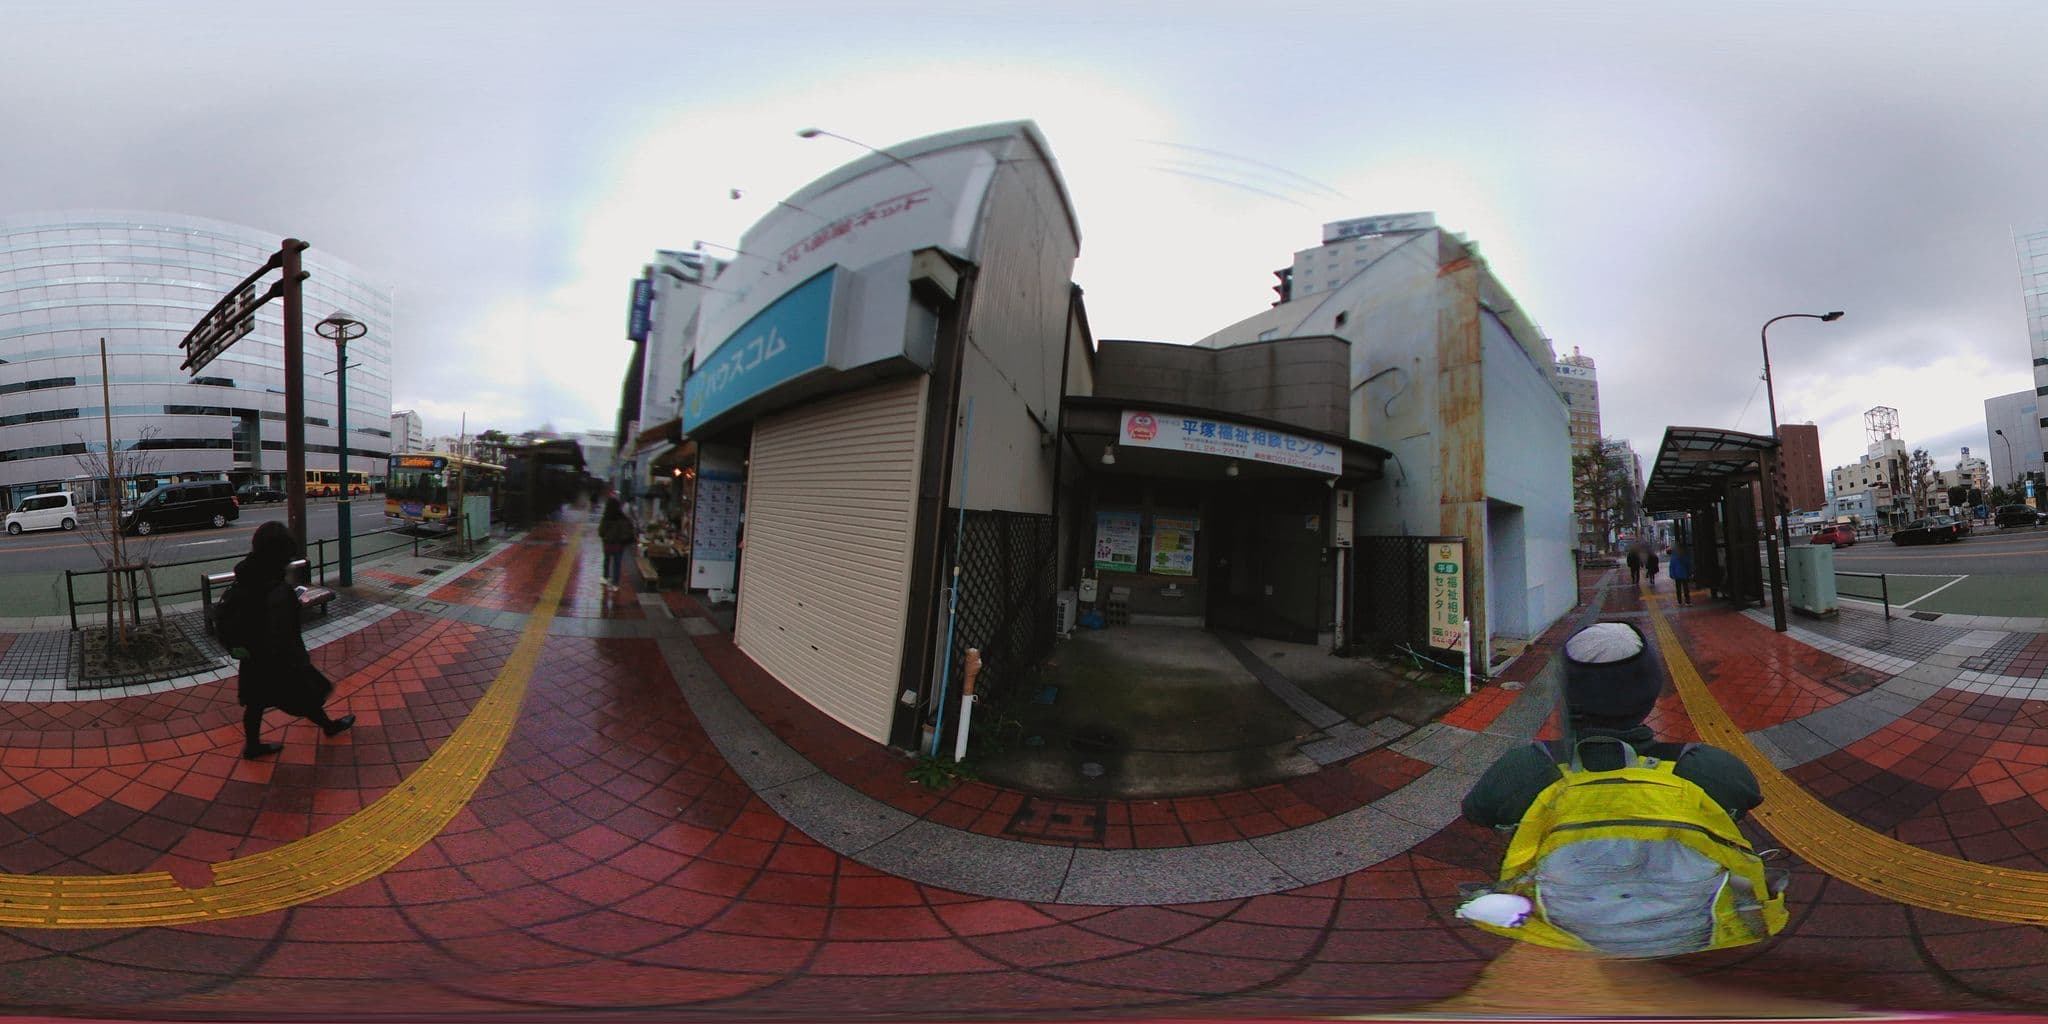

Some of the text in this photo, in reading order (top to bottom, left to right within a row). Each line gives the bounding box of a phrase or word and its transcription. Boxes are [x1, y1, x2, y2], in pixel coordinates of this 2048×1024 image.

[705, 325, 786, 398] ハウスコム
[1182, 419, 1337, 457] 平塚福祉相談センター
[1434, 576, 1444, 622] センター
